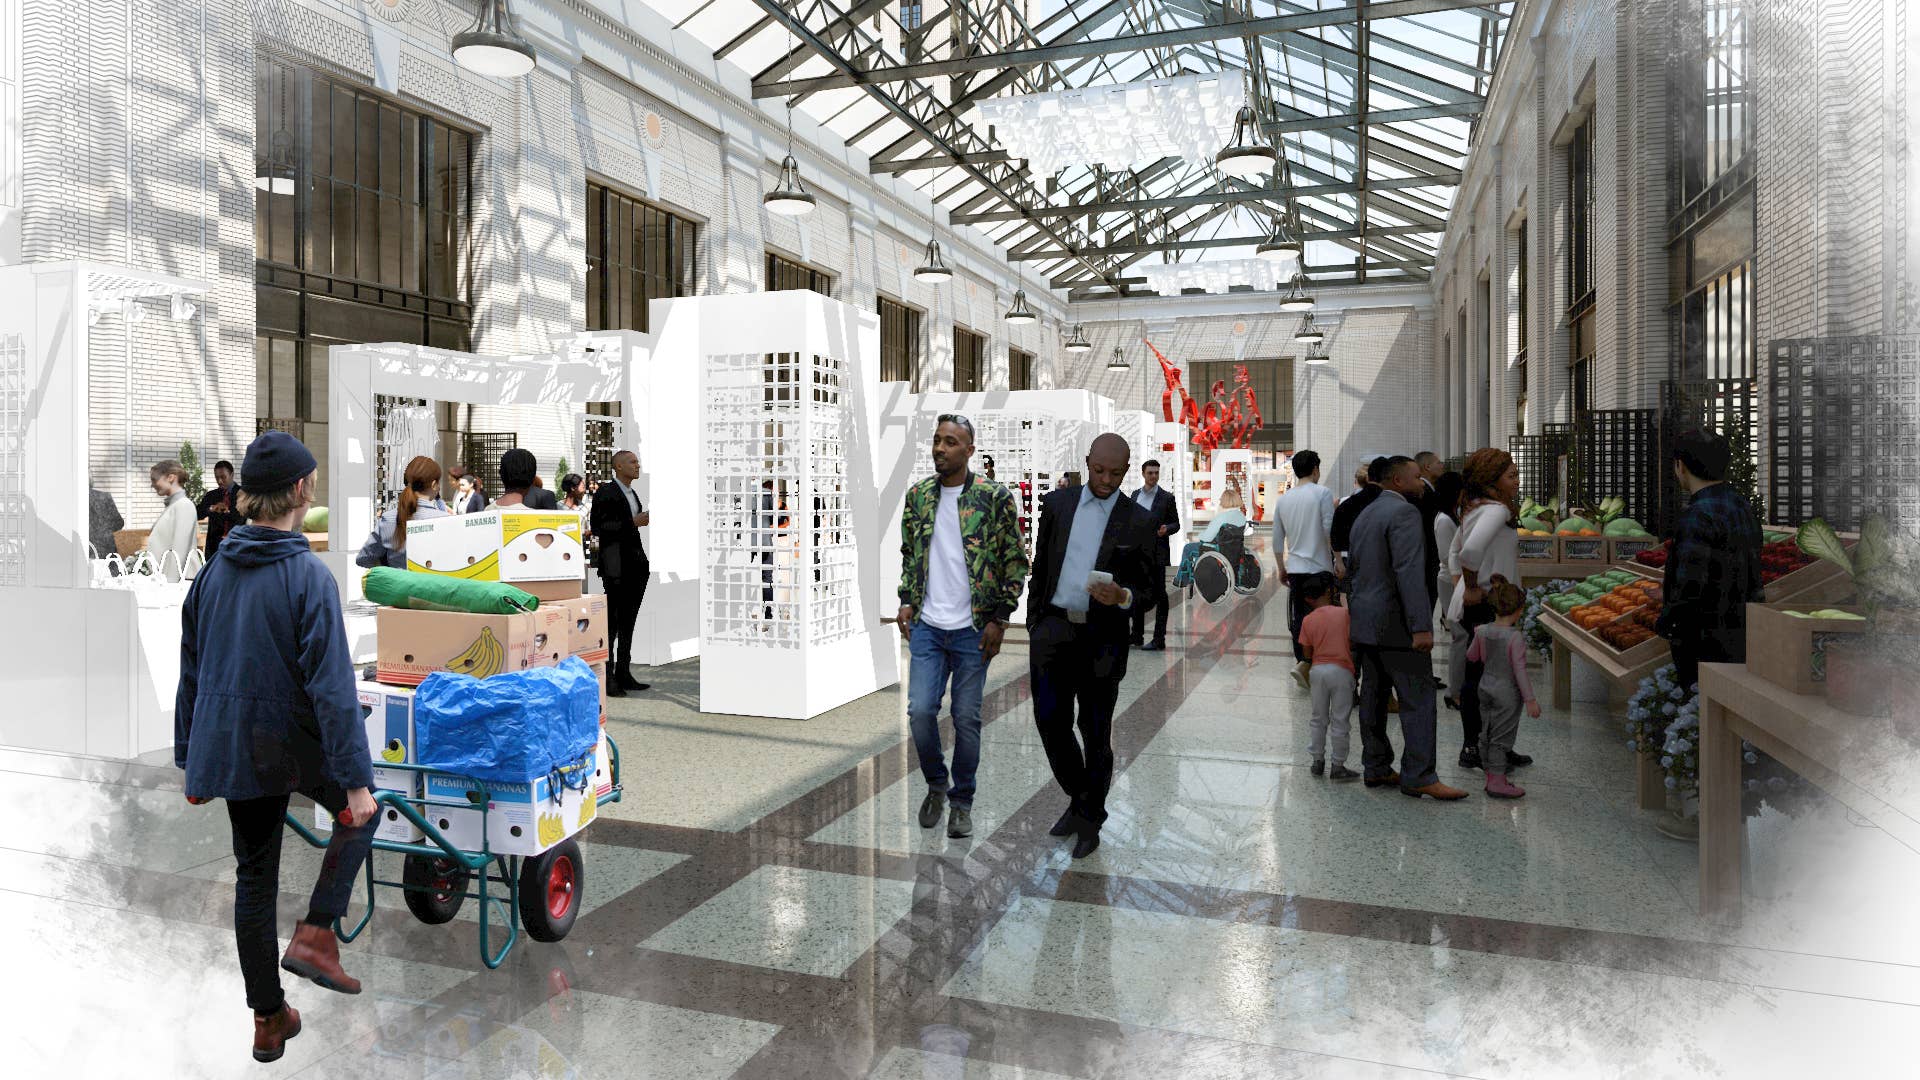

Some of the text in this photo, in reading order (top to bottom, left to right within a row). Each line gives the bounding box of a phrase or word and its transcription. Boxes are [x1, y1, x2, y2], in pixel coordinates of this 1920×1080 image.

[407, 524, 434, 535] PREMIUM
[465, 516, 497, 528] BANANAS
[379, 661, 411, 672] PREMIUM
[432, 777, 528, 794] PREMIUM ANANAS
